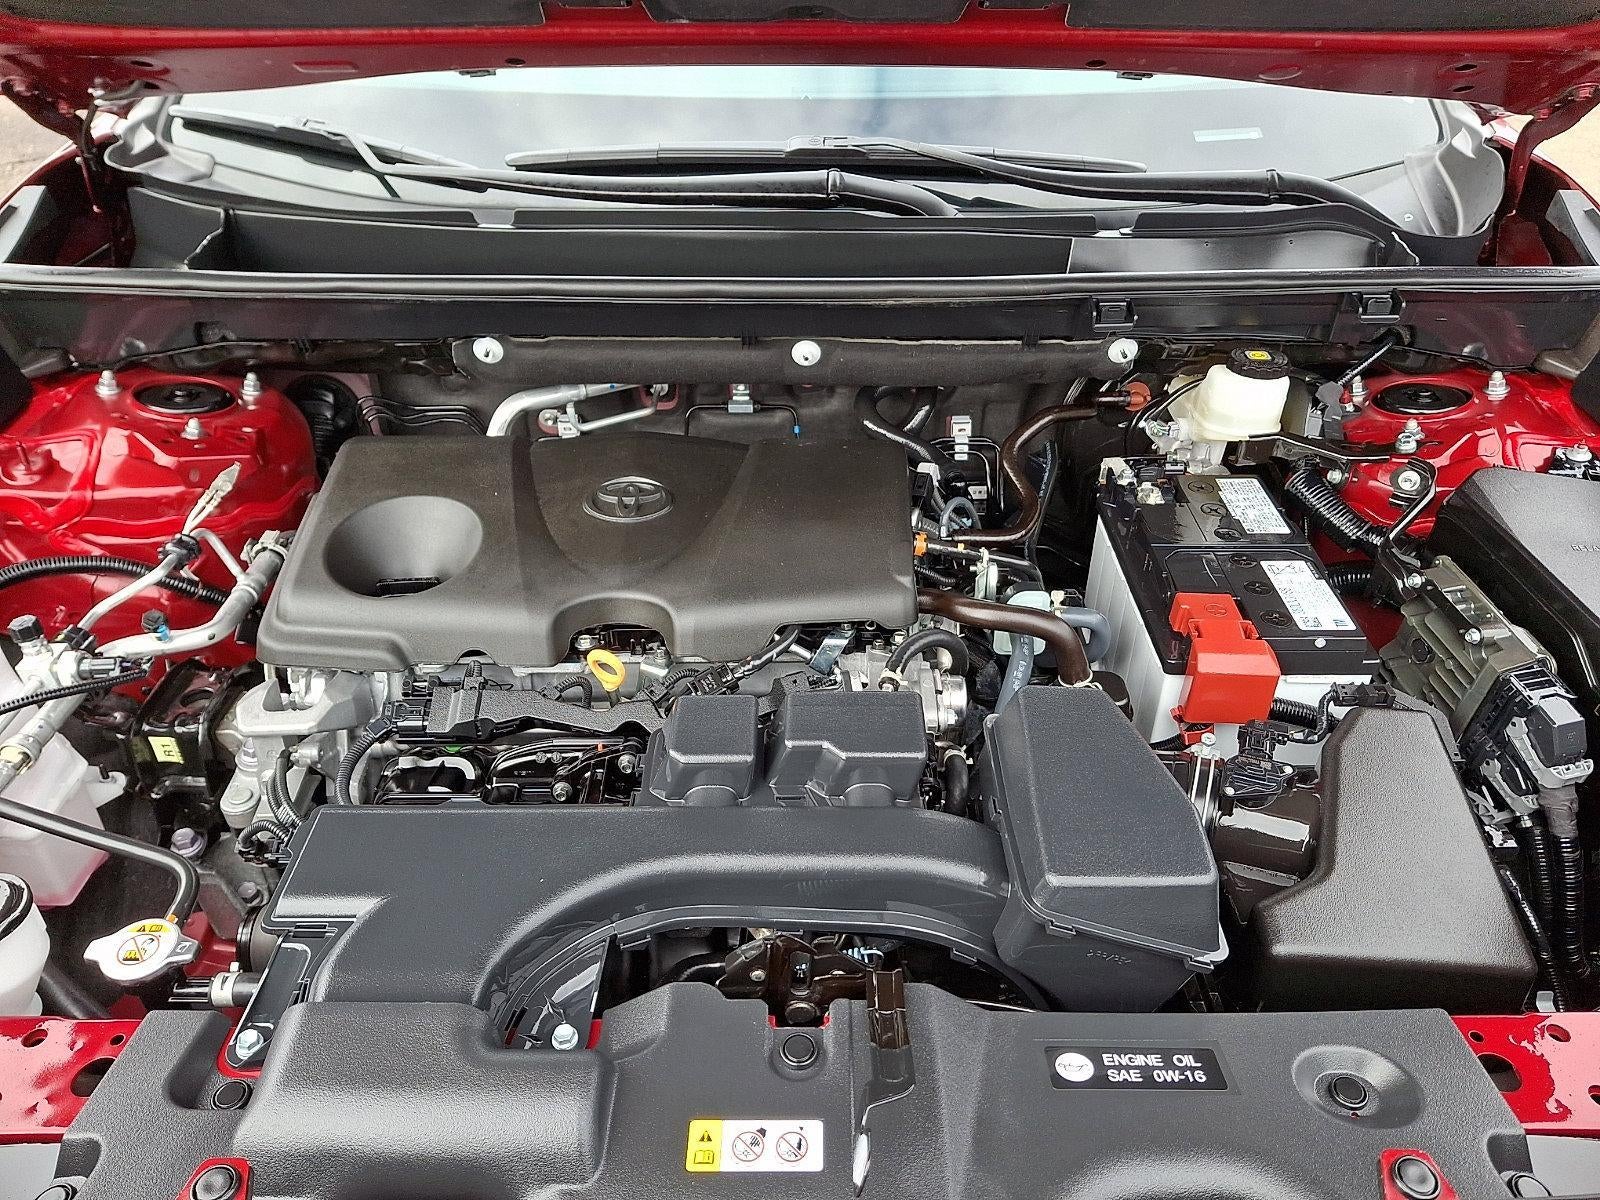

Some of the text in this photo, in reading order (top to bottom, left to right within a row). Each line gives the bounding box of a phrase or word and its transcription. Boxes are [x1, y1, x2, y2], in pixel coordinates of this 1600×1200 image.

[161, 744, 175, 757] R1
[1102, 1054, 1202, 1067] ENGINE OIL
[1106, 1069, 1207, 1083] SAE 0W-16
